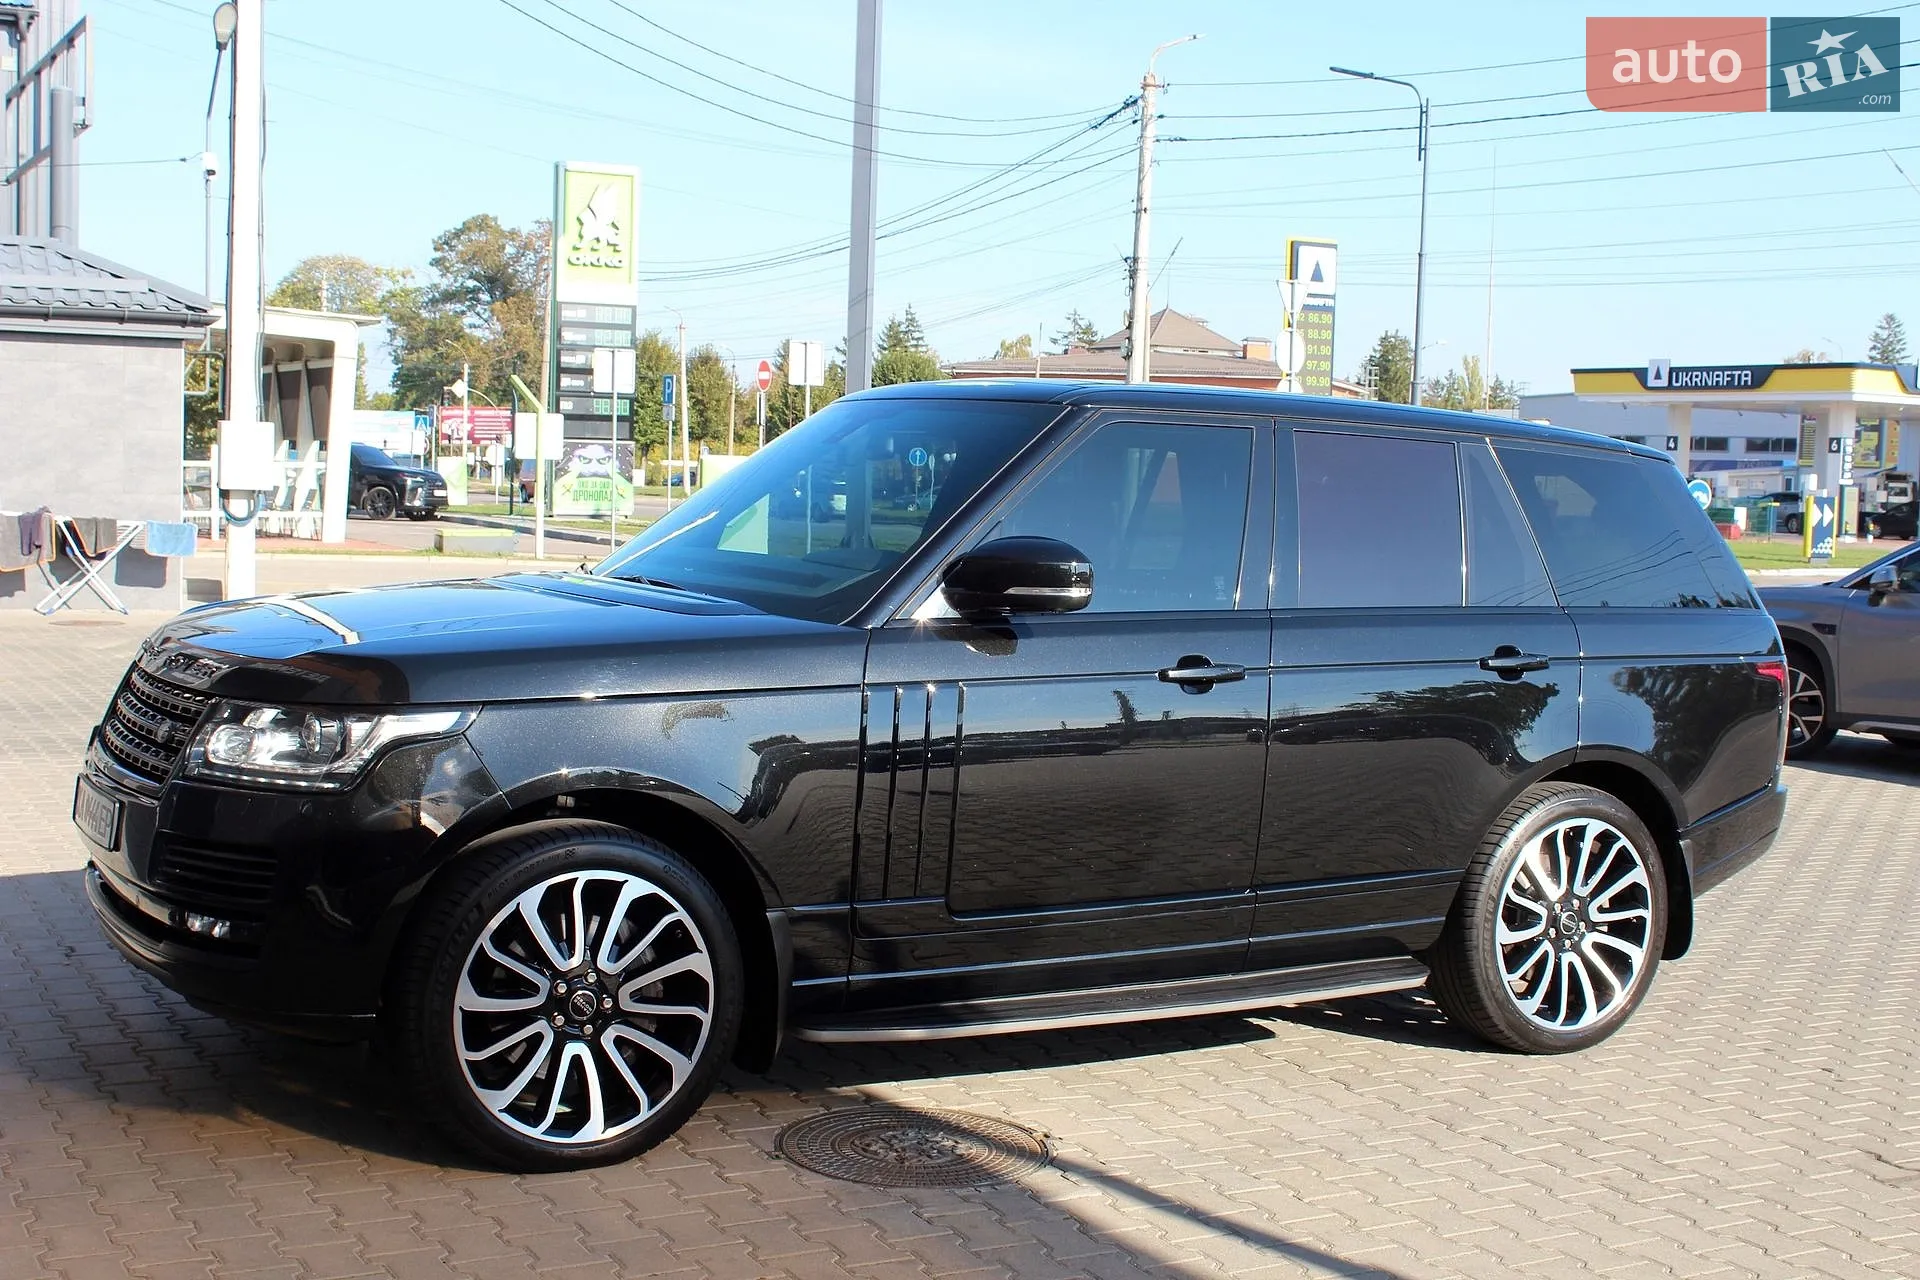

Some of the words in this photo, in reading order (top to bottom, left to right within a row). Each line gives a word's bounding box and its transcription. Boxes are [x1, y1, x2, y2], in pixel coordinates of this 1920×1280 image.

[1307, 344, 1331, 355] 91.90
[1306, 360, 1331, 371] 97.90
[1306, 376, 1330, 386] 99.90
[1672, 370, 1752, 387] UKRNAFTA
[665, 377, 673, 402] P
[1668, 437, 1675, 449] 4
[1831, 439, 1838, 451] 6
